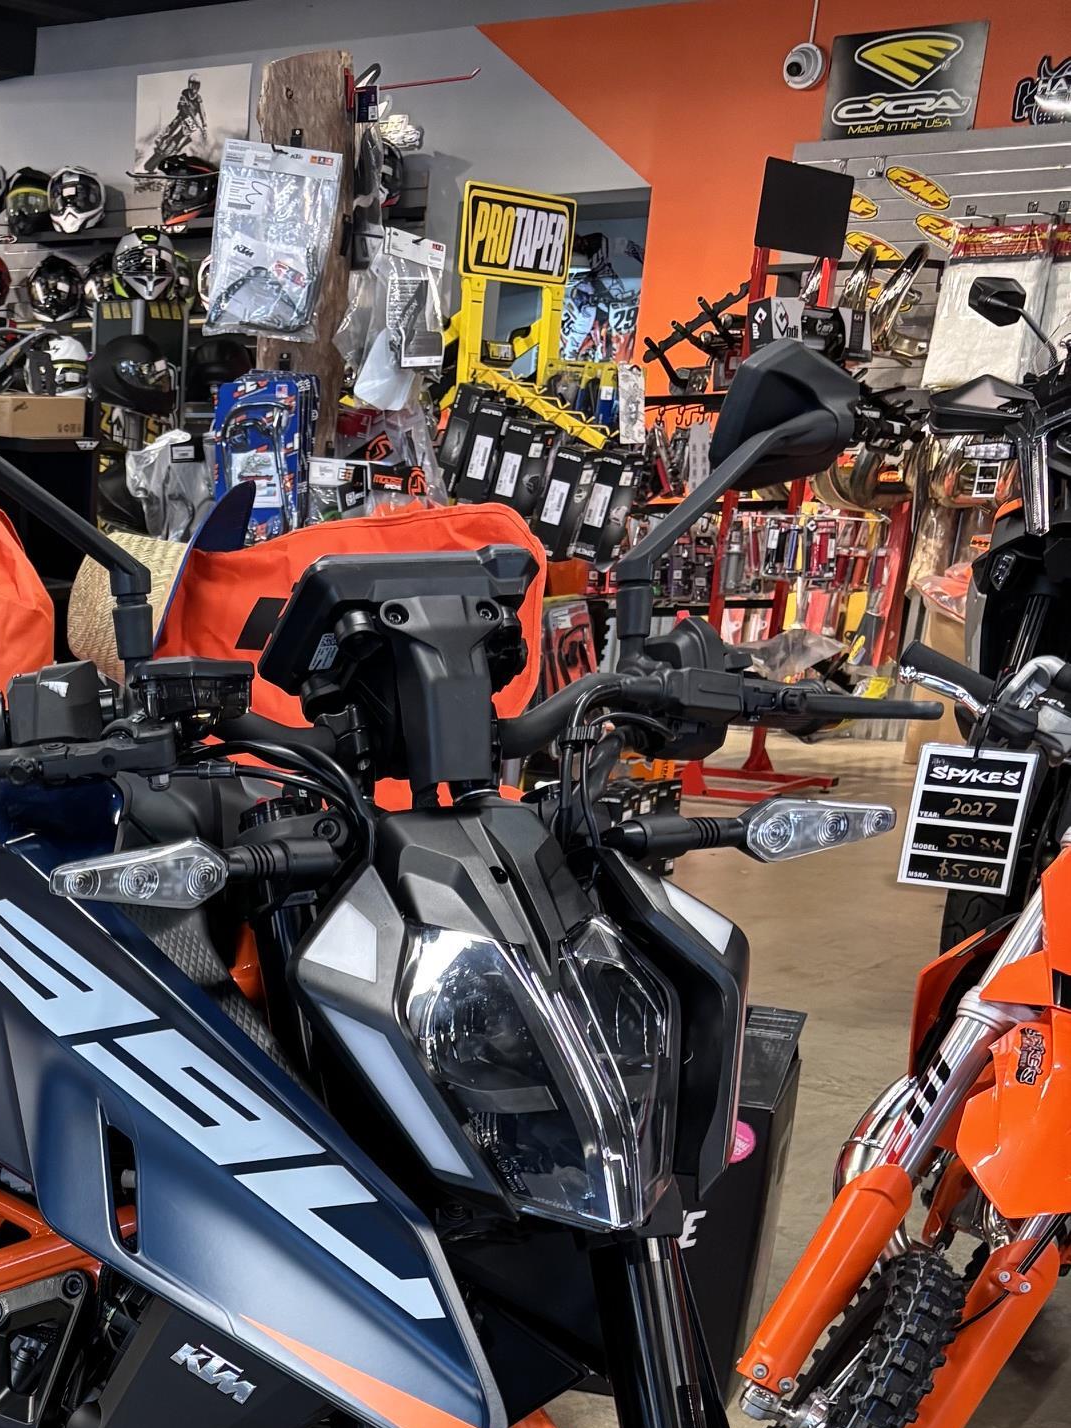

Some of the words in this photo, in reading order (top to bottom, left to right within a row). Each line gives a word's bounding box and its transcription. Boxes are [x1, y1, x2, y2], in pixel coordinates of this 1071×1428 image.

[838, 96, 960, 118] CYCRA
[847, 123, 885, 135] Made
[887, 122, 898, 132] in
[900, 120, 922, 130] the
[924, 117, 952, 129] USA
[887, 167, 950, 208] FMF
[233, 244, 255, 258] KTM
[613, 306, 637, 331] 29
[930, 765, 1021, 786] SPYKE'S
[919, 811, 940, 819] YEAR:
[945, 797, 998, 818] 2027
[912, 842, 939, 851] MODEL:
[908, 870, 929, 879] MSRP:
[169, 1342, 258, 1404] KTM
